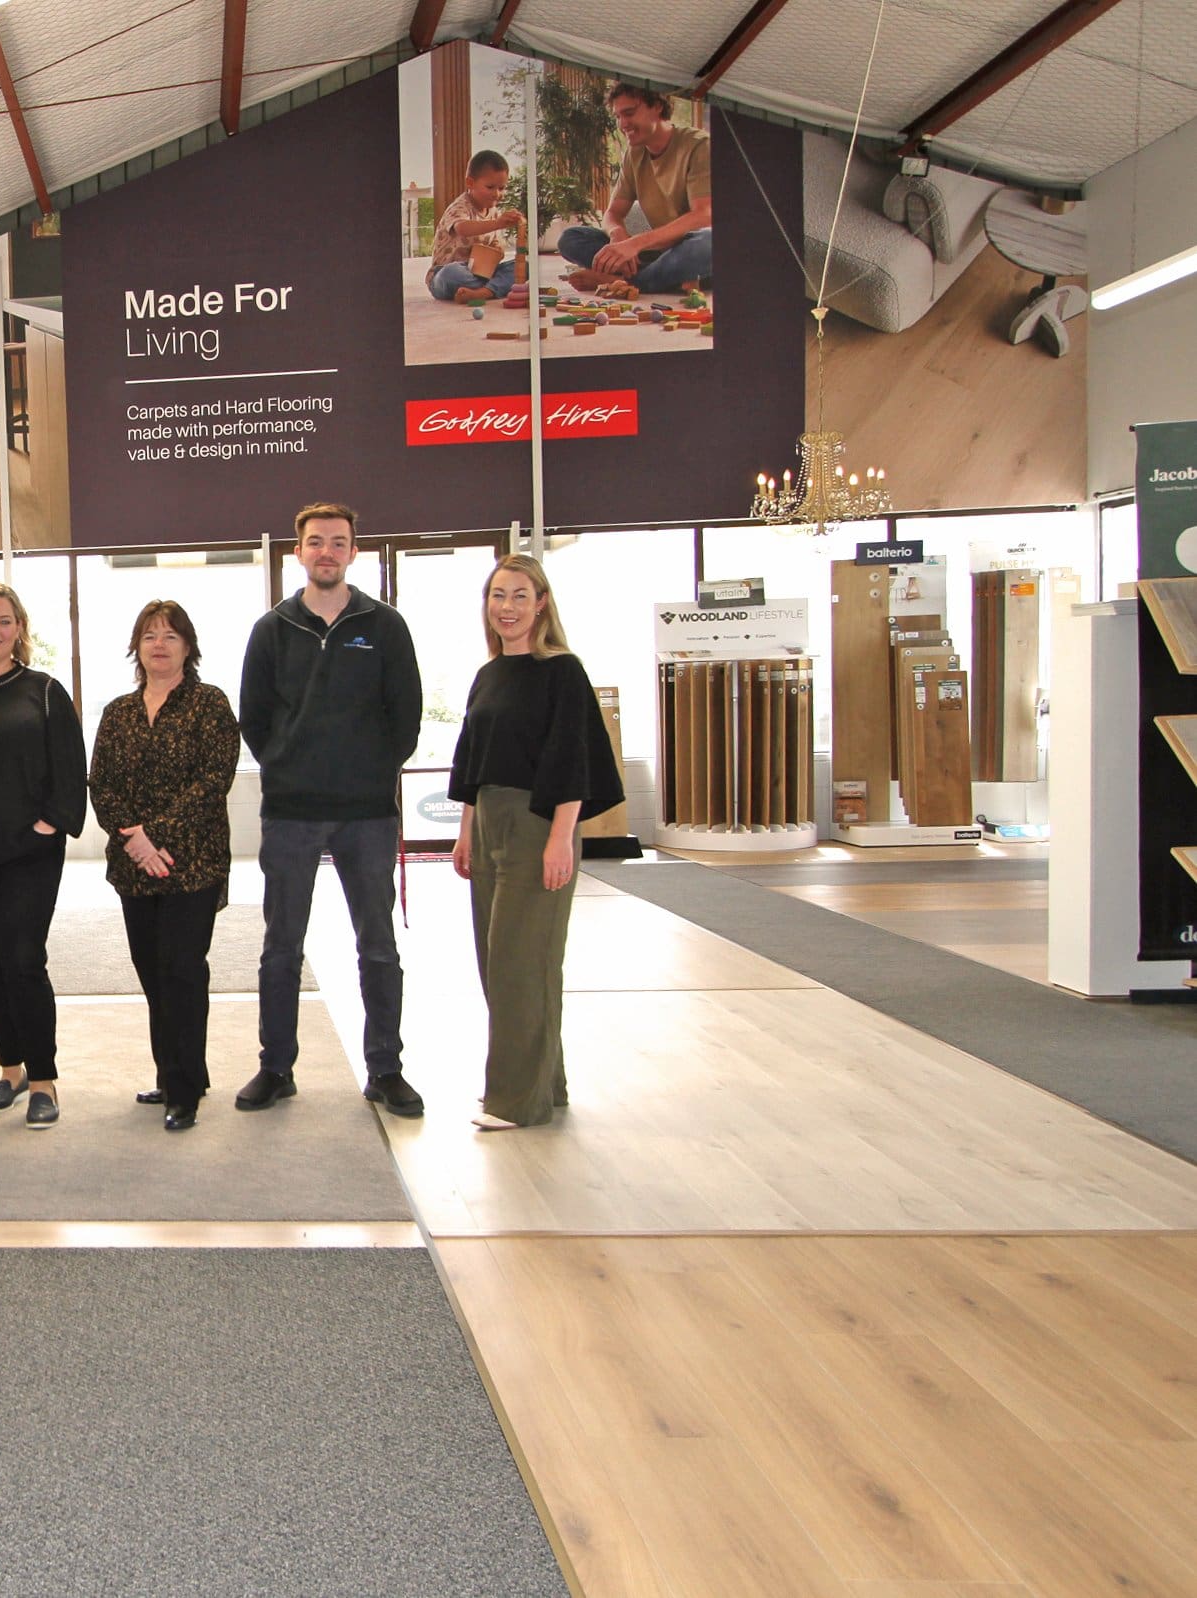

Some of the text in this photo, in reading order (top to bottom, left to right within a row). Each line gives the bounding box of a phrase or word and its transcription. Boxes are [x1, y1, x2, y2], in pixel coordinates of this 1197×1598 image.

[124, 283, 293, 320] Made For
[125, 326, 220, 361] Living
[126, 396, 333, 421] Carpets and Hard Flooring
[418, 403, 632, 437] Godfrey Hirst
[127, 418, 317, 440] made with performance,
[127, 437, 308, 461] value & design in mind.
[866, 547, 913, 558] balterio
[678, 609, 803, 623] WOODLAND LIFESTYLE
